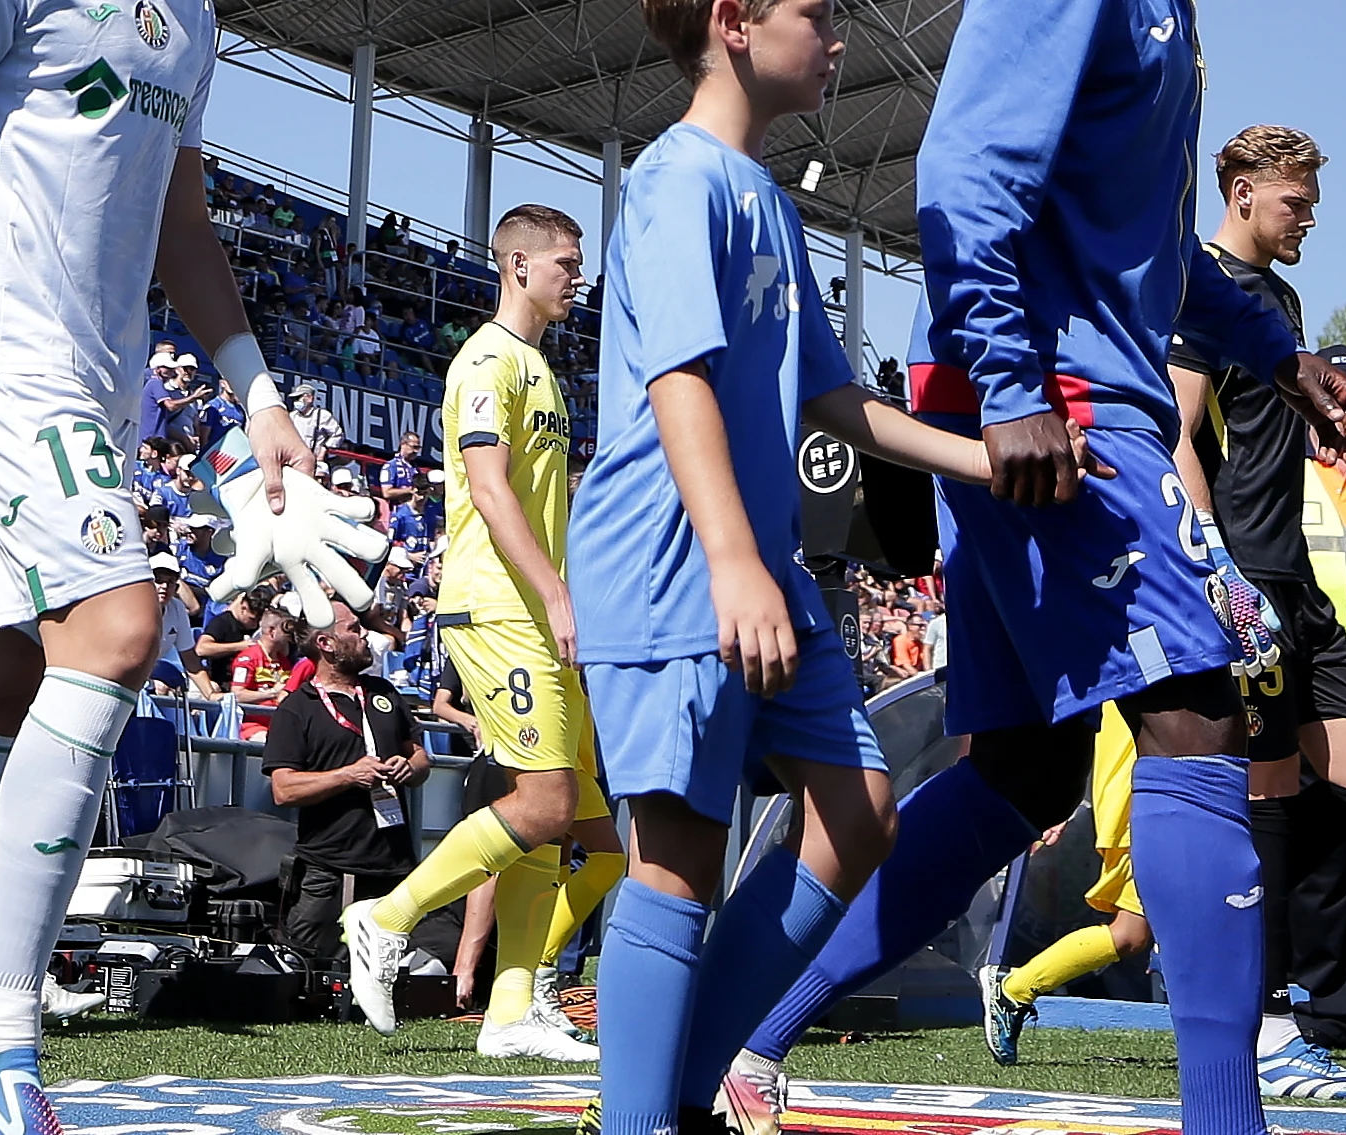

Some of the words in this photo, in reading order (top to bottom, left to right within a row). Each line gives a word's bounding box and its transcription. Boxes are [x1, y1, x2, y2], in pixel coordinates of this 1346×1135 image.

[35, 421, 122, 500] 13
[809, 442, 840, 463] RF
[811, 460, 842, 481] EF
[508, 667, 534, 715] 8
